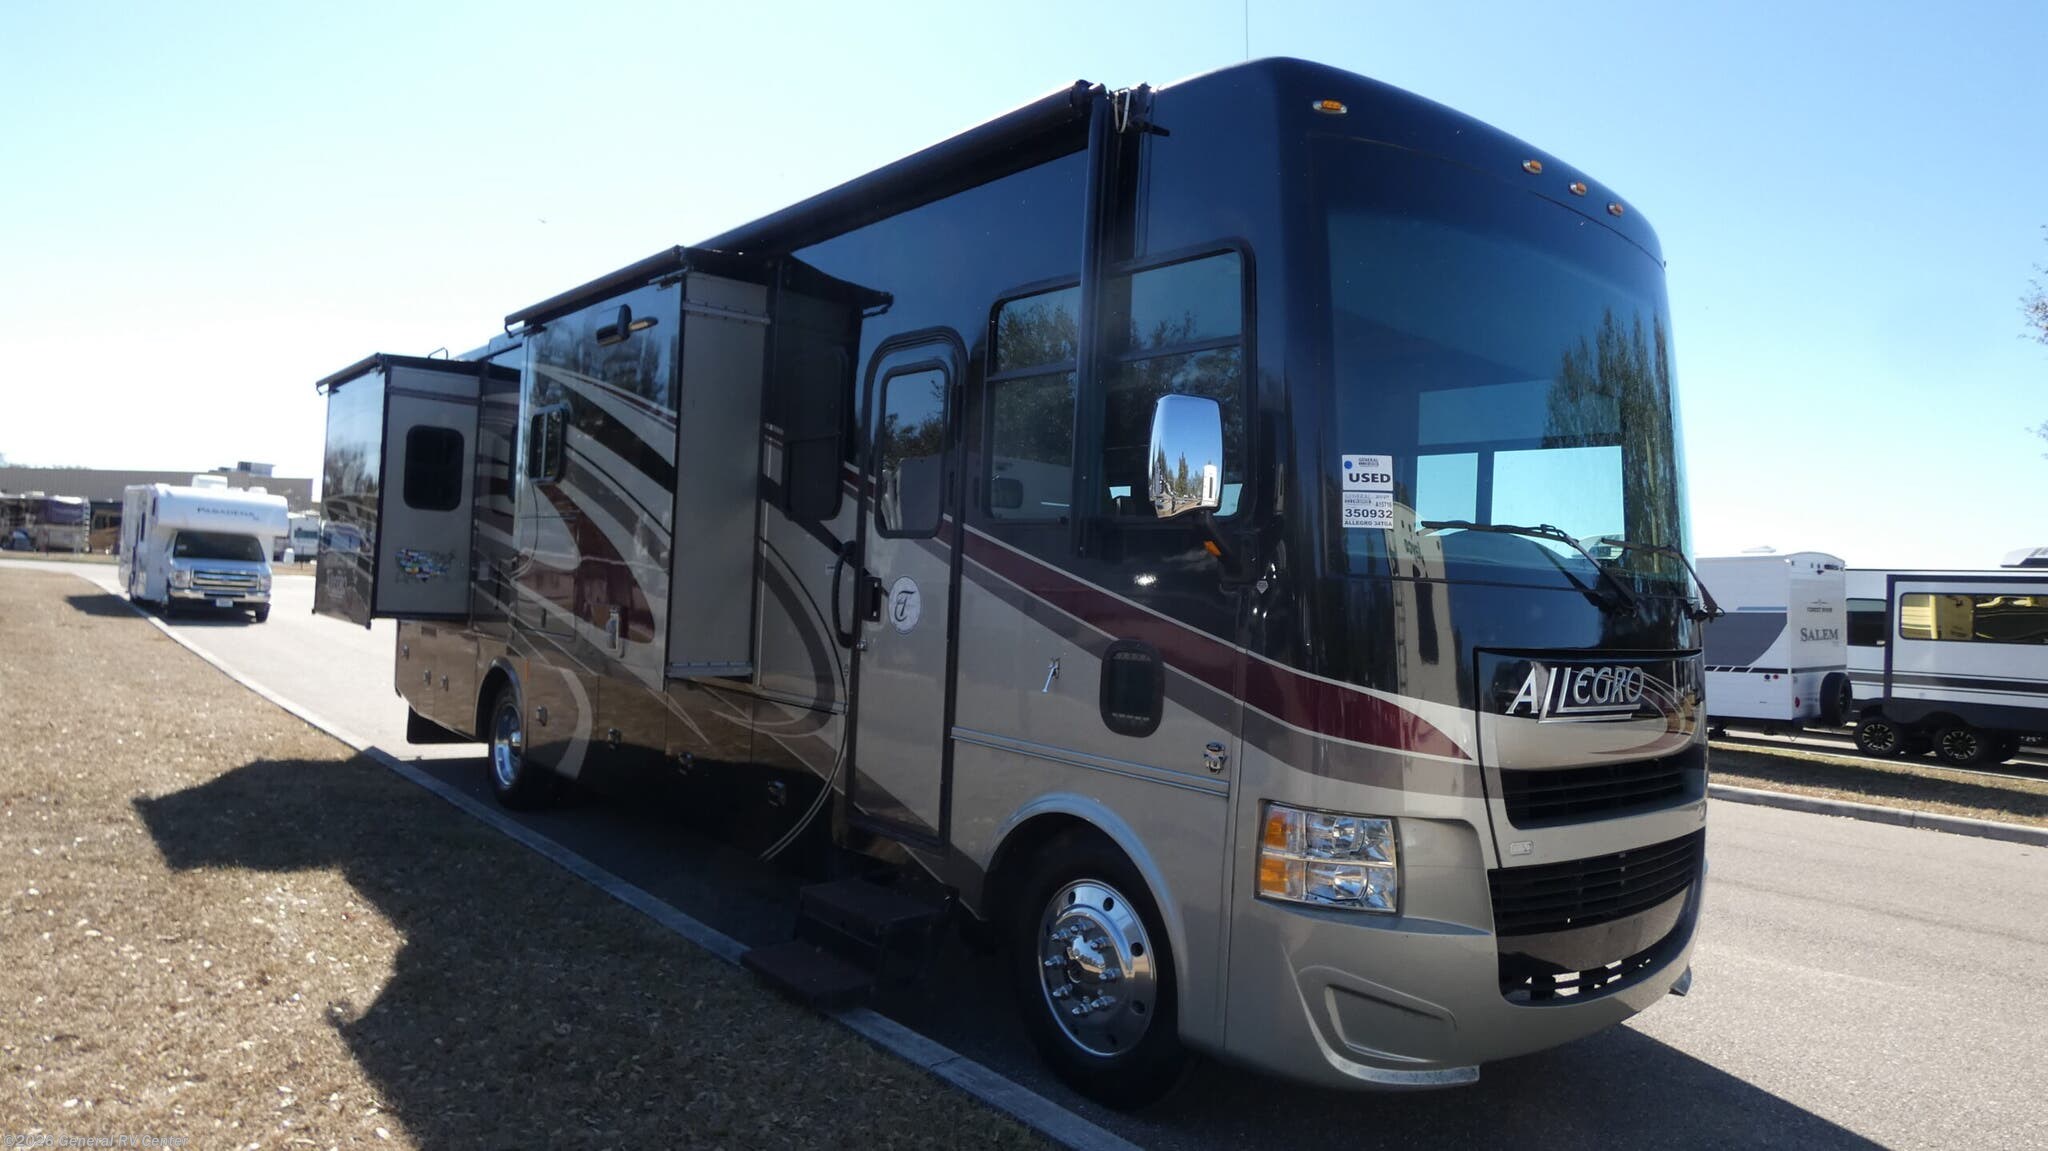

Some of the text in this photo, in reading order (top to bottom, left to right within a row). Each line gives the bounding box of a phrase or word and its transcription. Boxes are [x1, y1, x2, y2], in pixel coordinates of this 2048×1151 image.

[1348, 473, 1391, 484] USED
[1344, 508, 1393, 519] 350932
[1799, 627, 1839, 642] SALEM
[1504, 665, 1645, 724] ALLEGRO
